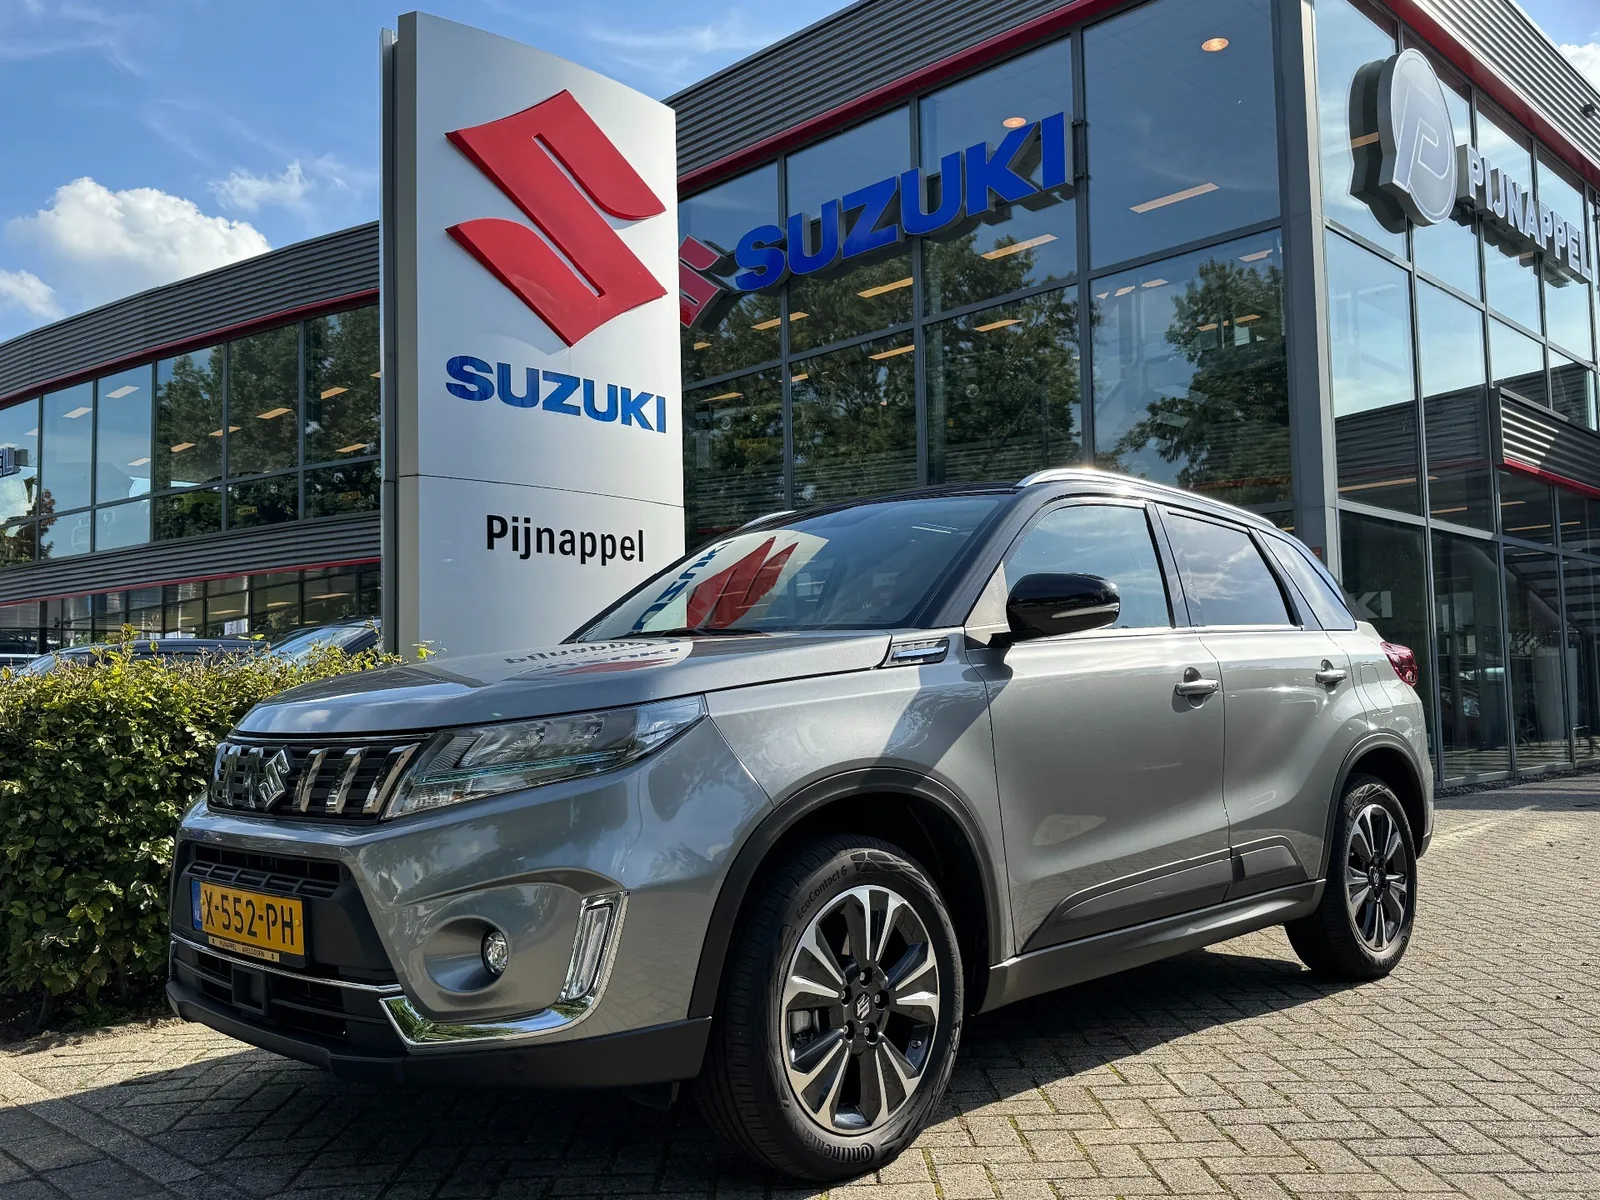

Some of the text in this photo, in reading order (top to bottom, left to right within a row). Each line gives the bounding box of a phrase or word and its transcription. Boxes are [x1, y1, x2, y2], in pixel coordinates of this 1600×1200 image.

[735, 111, 1066, 291] SUZUKI
[1465, 144, 1592, 283] PIJNAPPEL
[446, 355, 667, 434] SUZUKI
[486, 514, 644, 566] Pijnappel
[204, 889, 295, 946] X-552-PH
[796, 865, 848, 921] EcoContact 6
